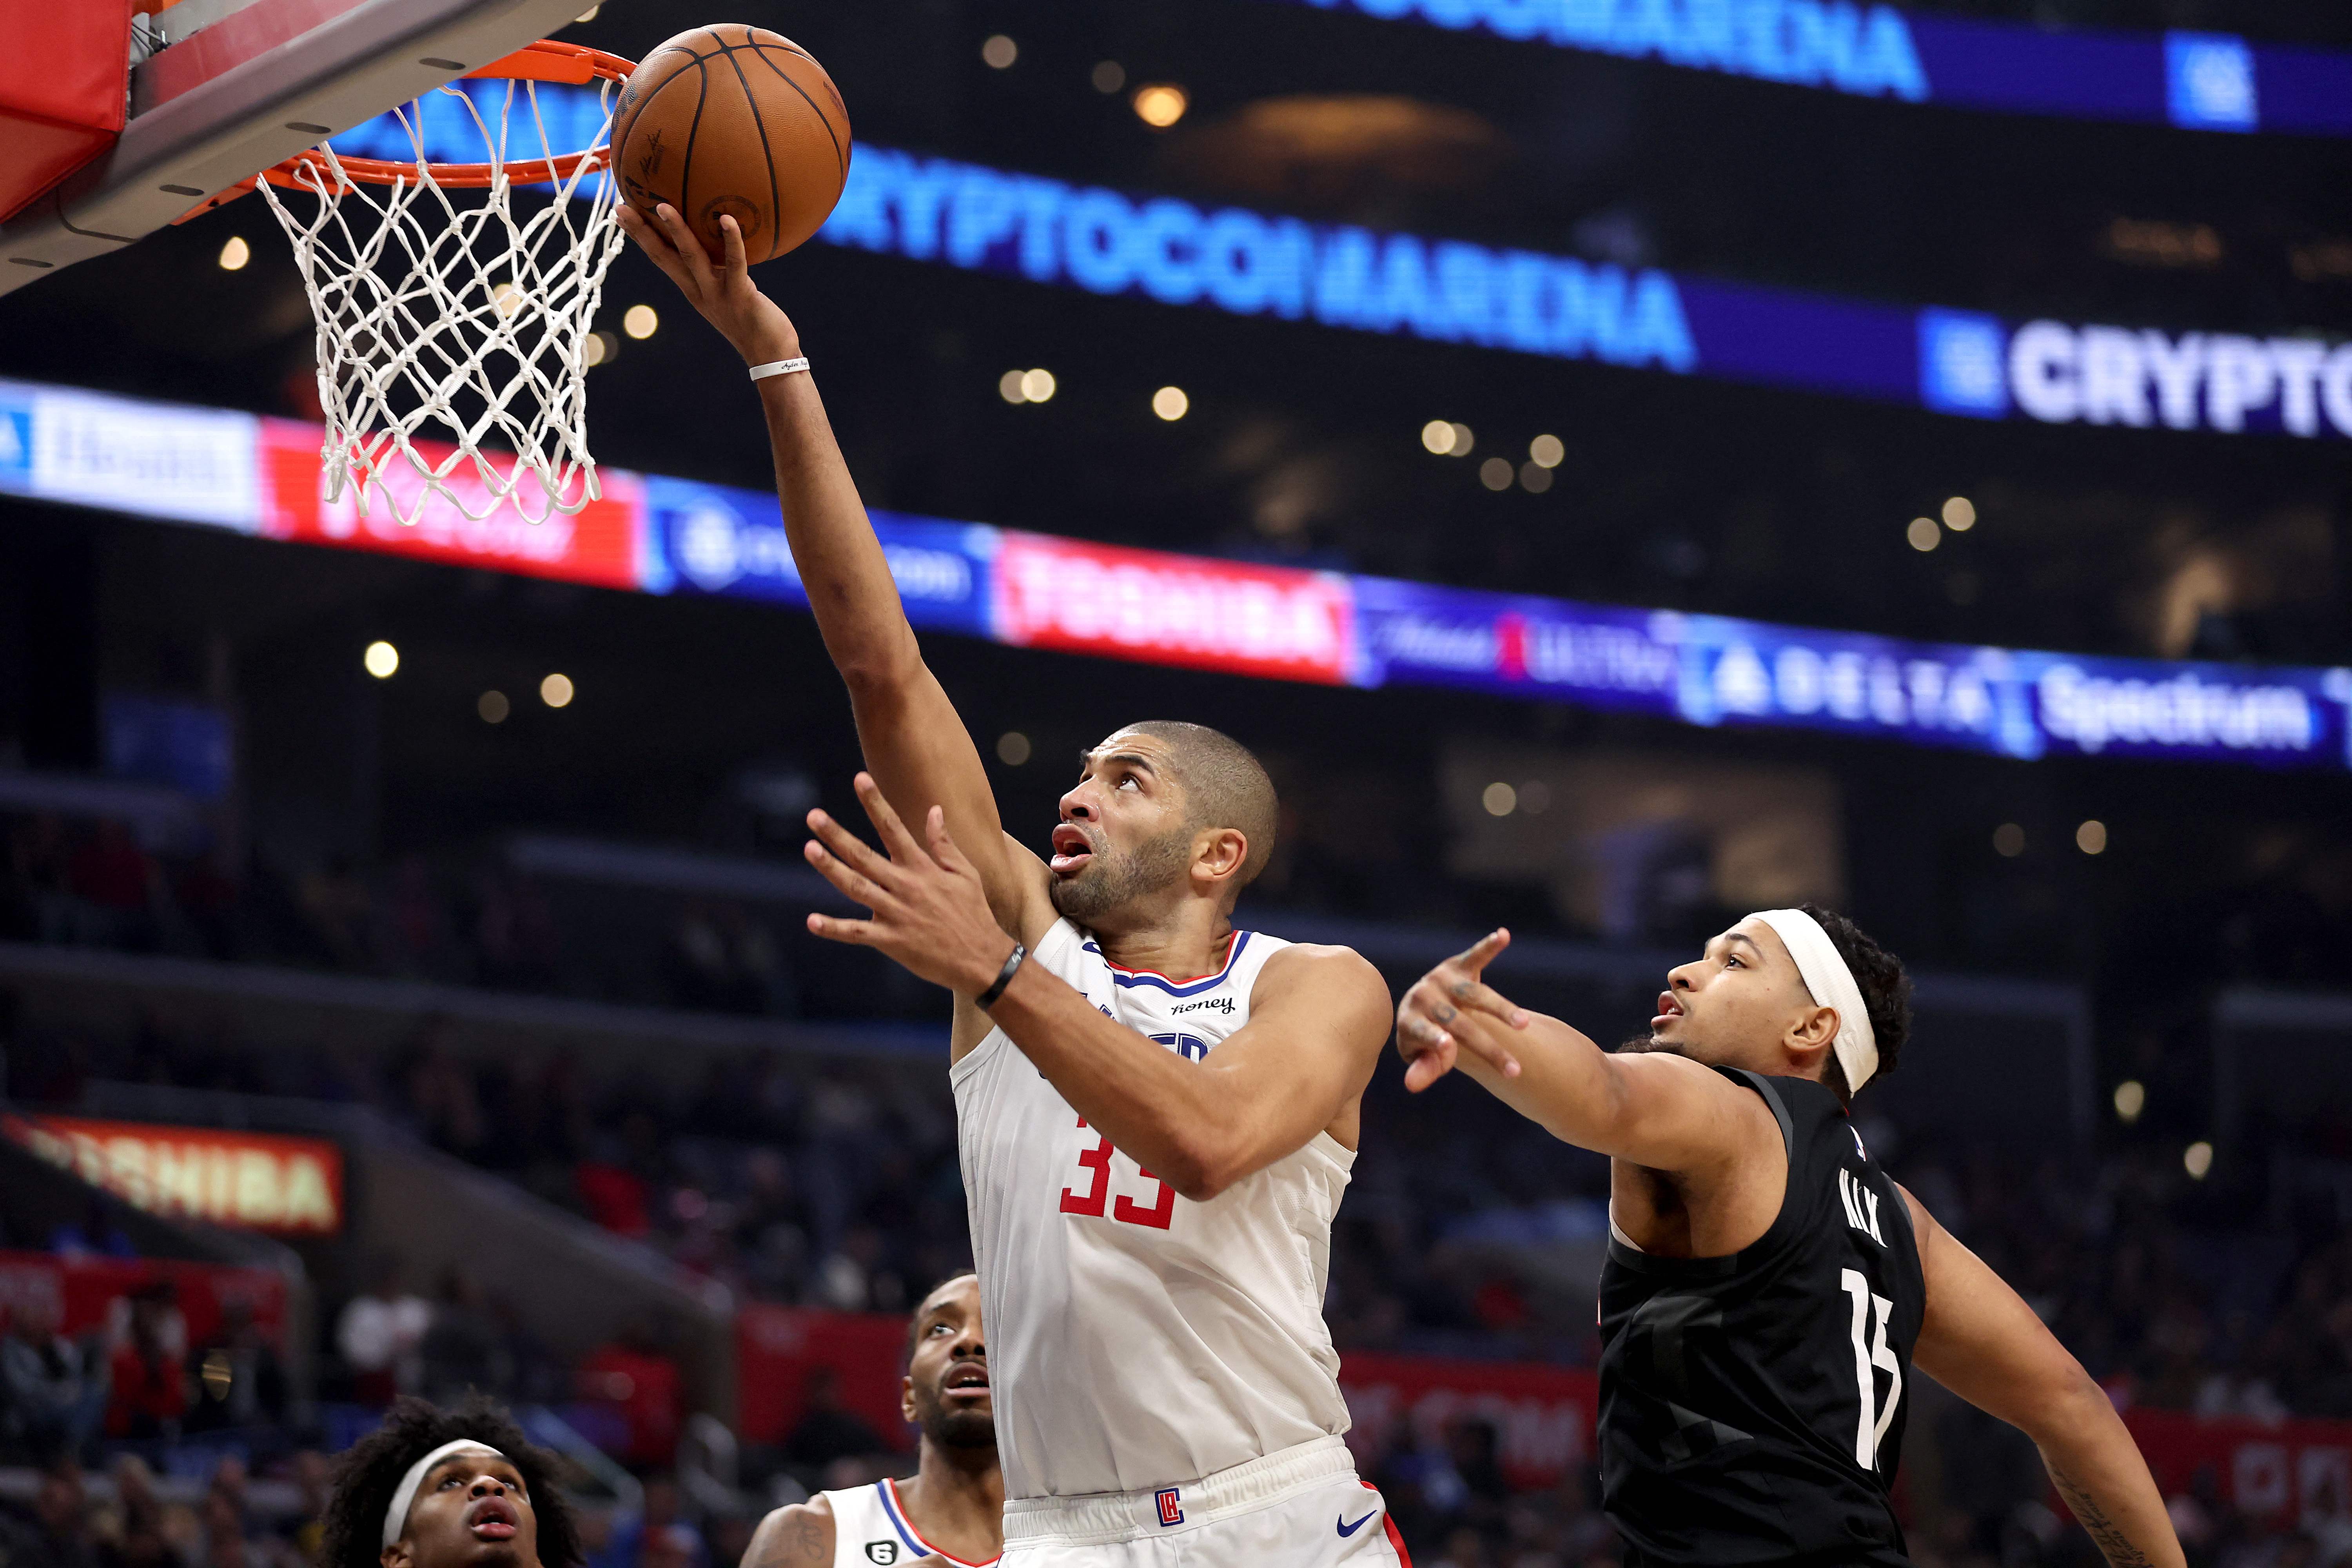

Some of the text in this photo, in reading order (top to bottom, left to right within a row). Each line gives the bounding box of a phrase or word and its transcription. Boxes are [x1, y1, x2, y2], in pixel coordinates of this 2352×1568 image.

[1171, 996, 1236, 1015] honey
[1841, 1268, 1902, 1473] 15
[871, 1543, 894, 1564] 6
